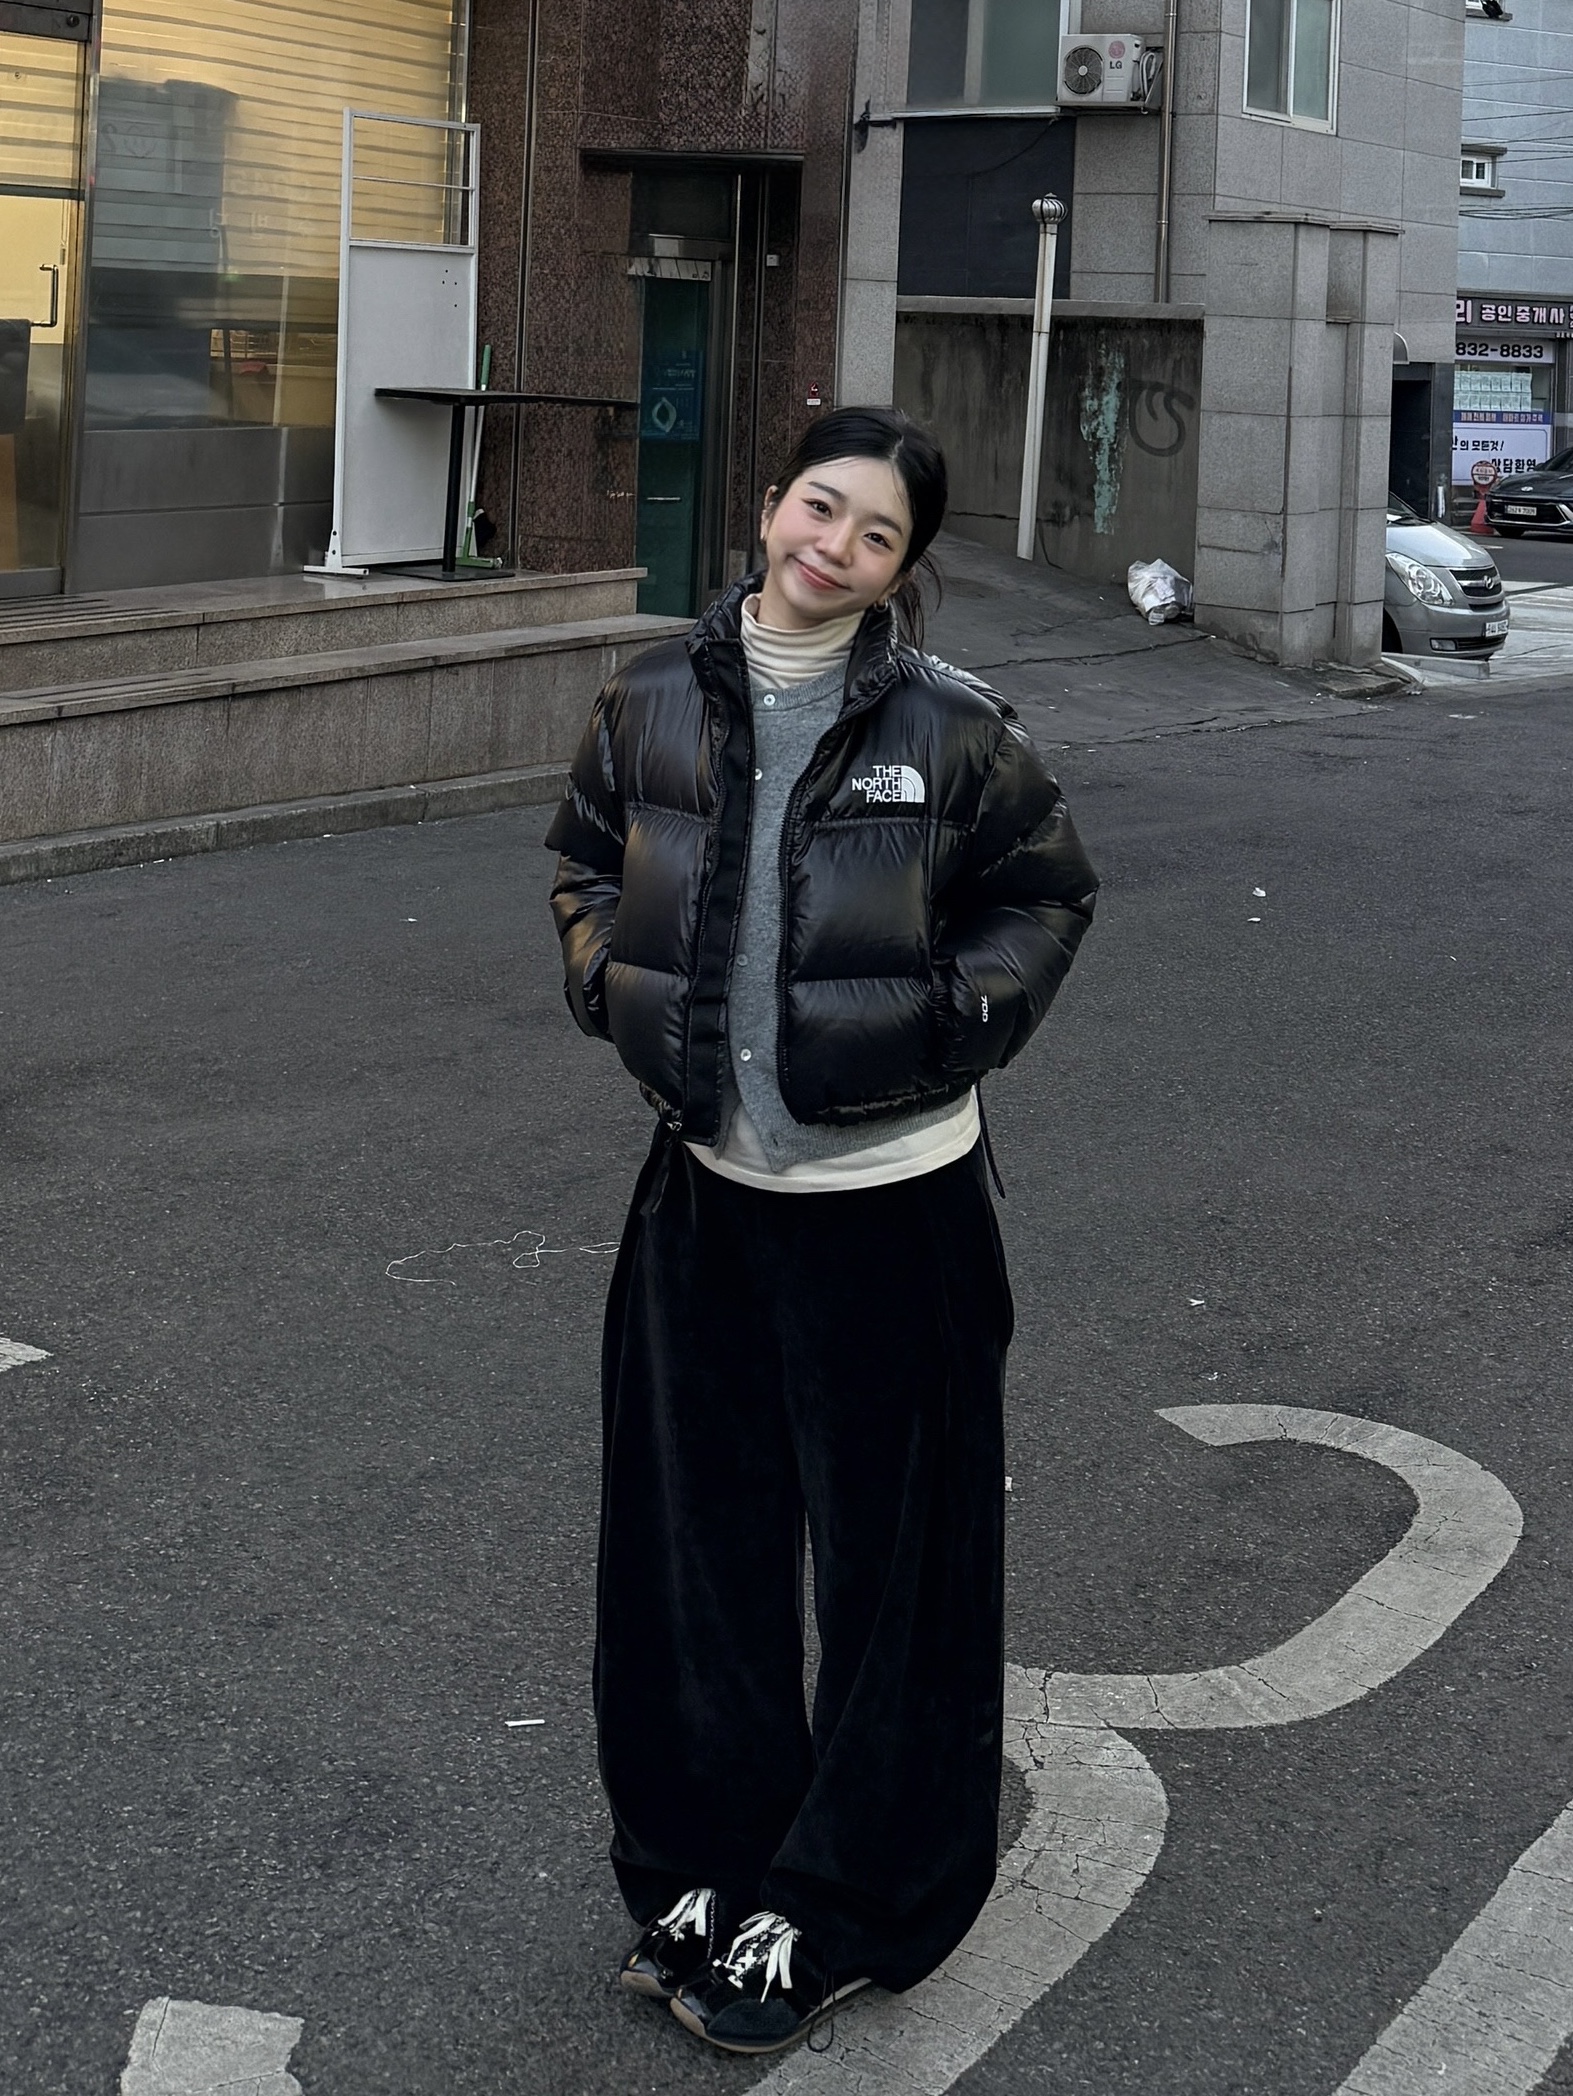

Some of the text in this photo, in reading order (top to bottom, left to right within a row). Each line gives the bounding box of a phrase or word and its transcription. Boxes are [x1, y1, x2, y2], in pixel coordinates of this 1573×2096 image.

[1109, 61, 1123, 69] LG
[1481, 304, 1565, 324] 공인중개사
[873, 766, 902, 778] THE
[851, 778, 902, 791] NORTH
[866, 790, 902, 803] FACE
[980, 995, 989, 1023] 700
